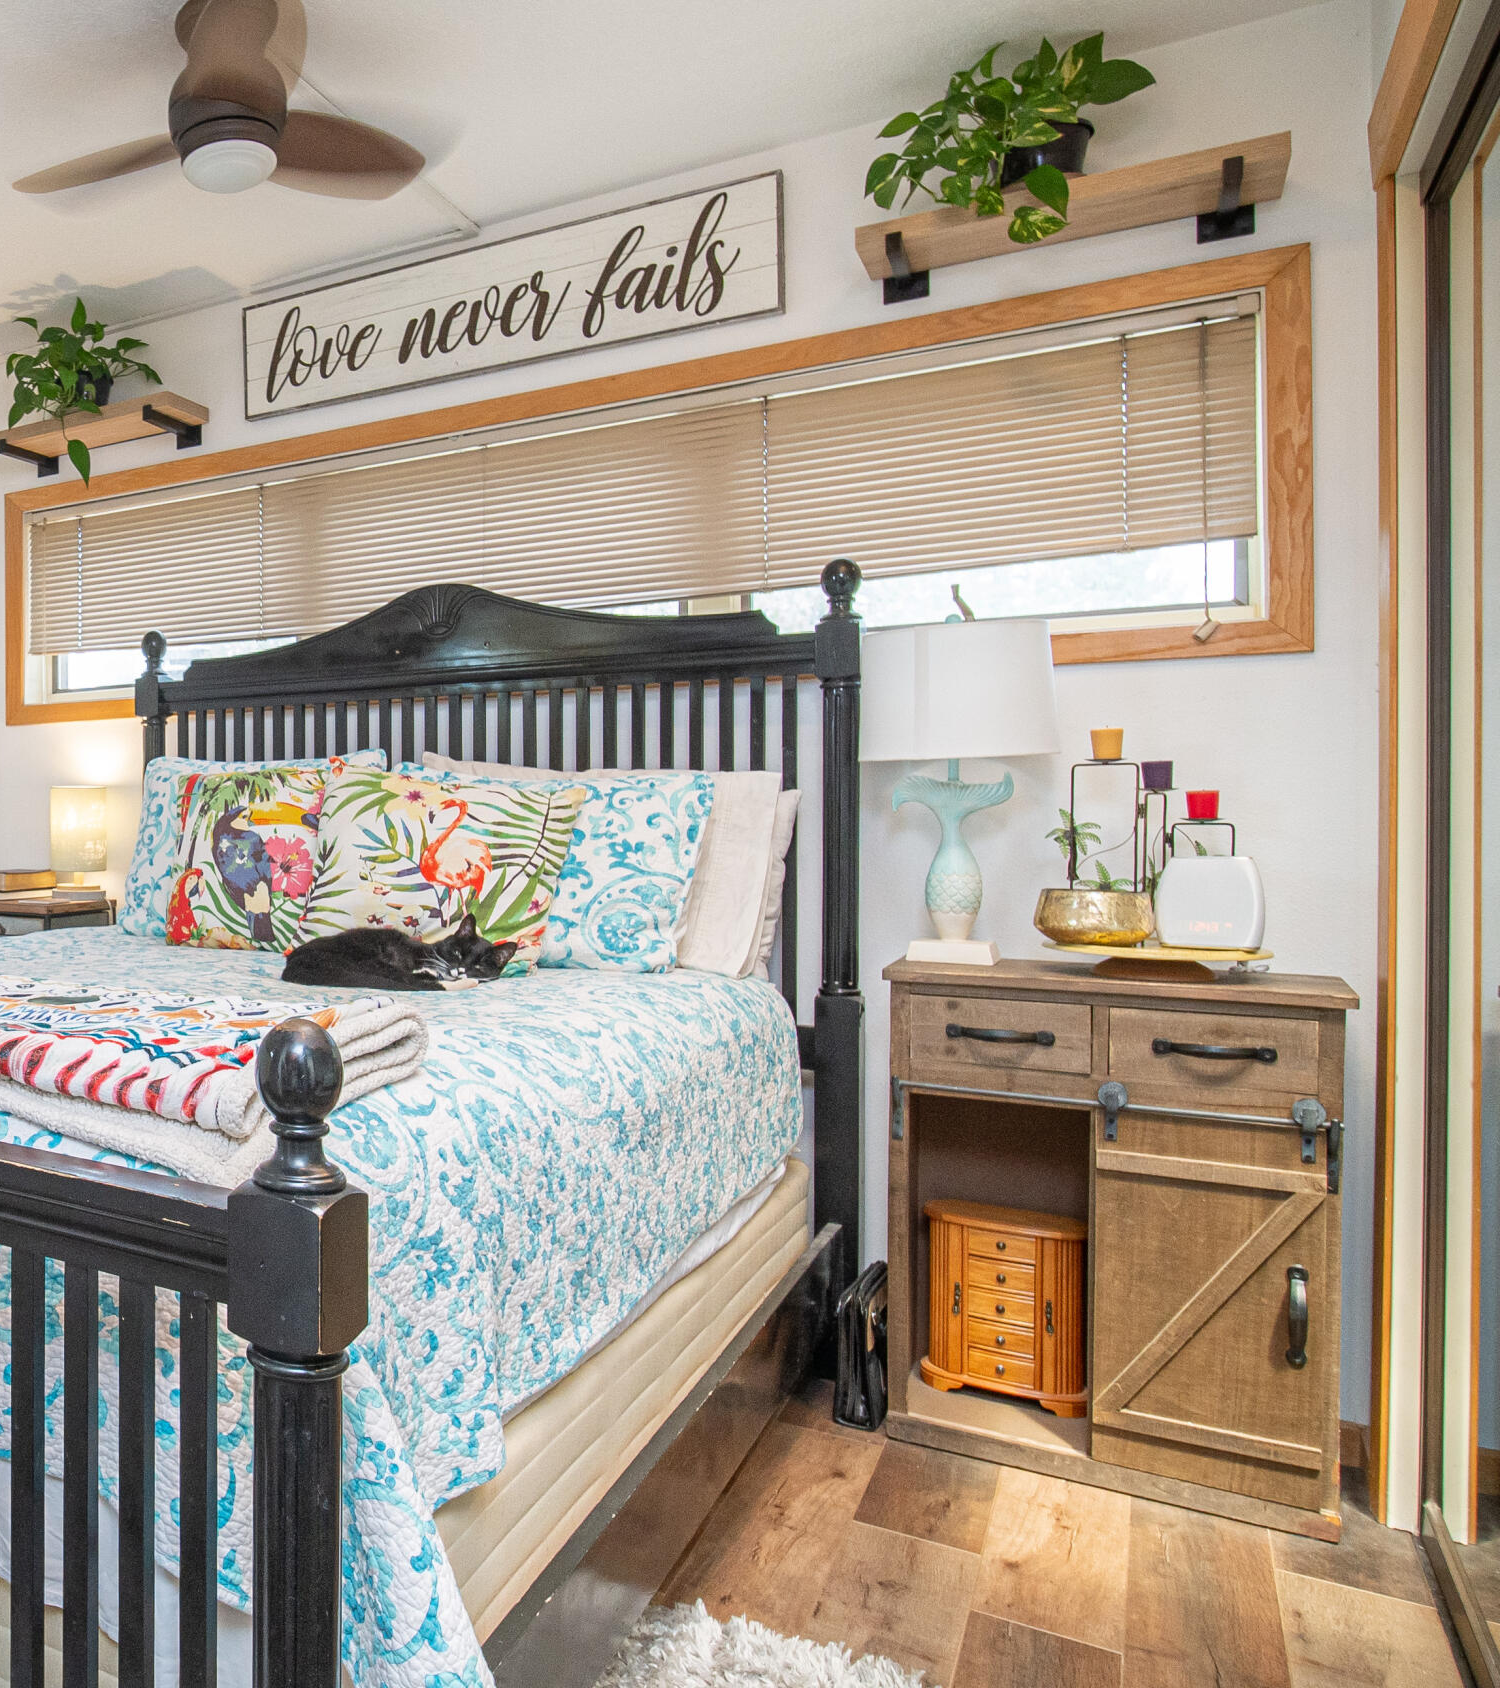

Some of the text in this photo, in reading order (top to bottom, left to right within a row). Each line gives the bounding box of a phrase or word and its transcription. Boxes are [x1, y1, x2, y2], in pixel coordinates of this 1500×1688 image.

[267, 192, 740, 403] love never fails
